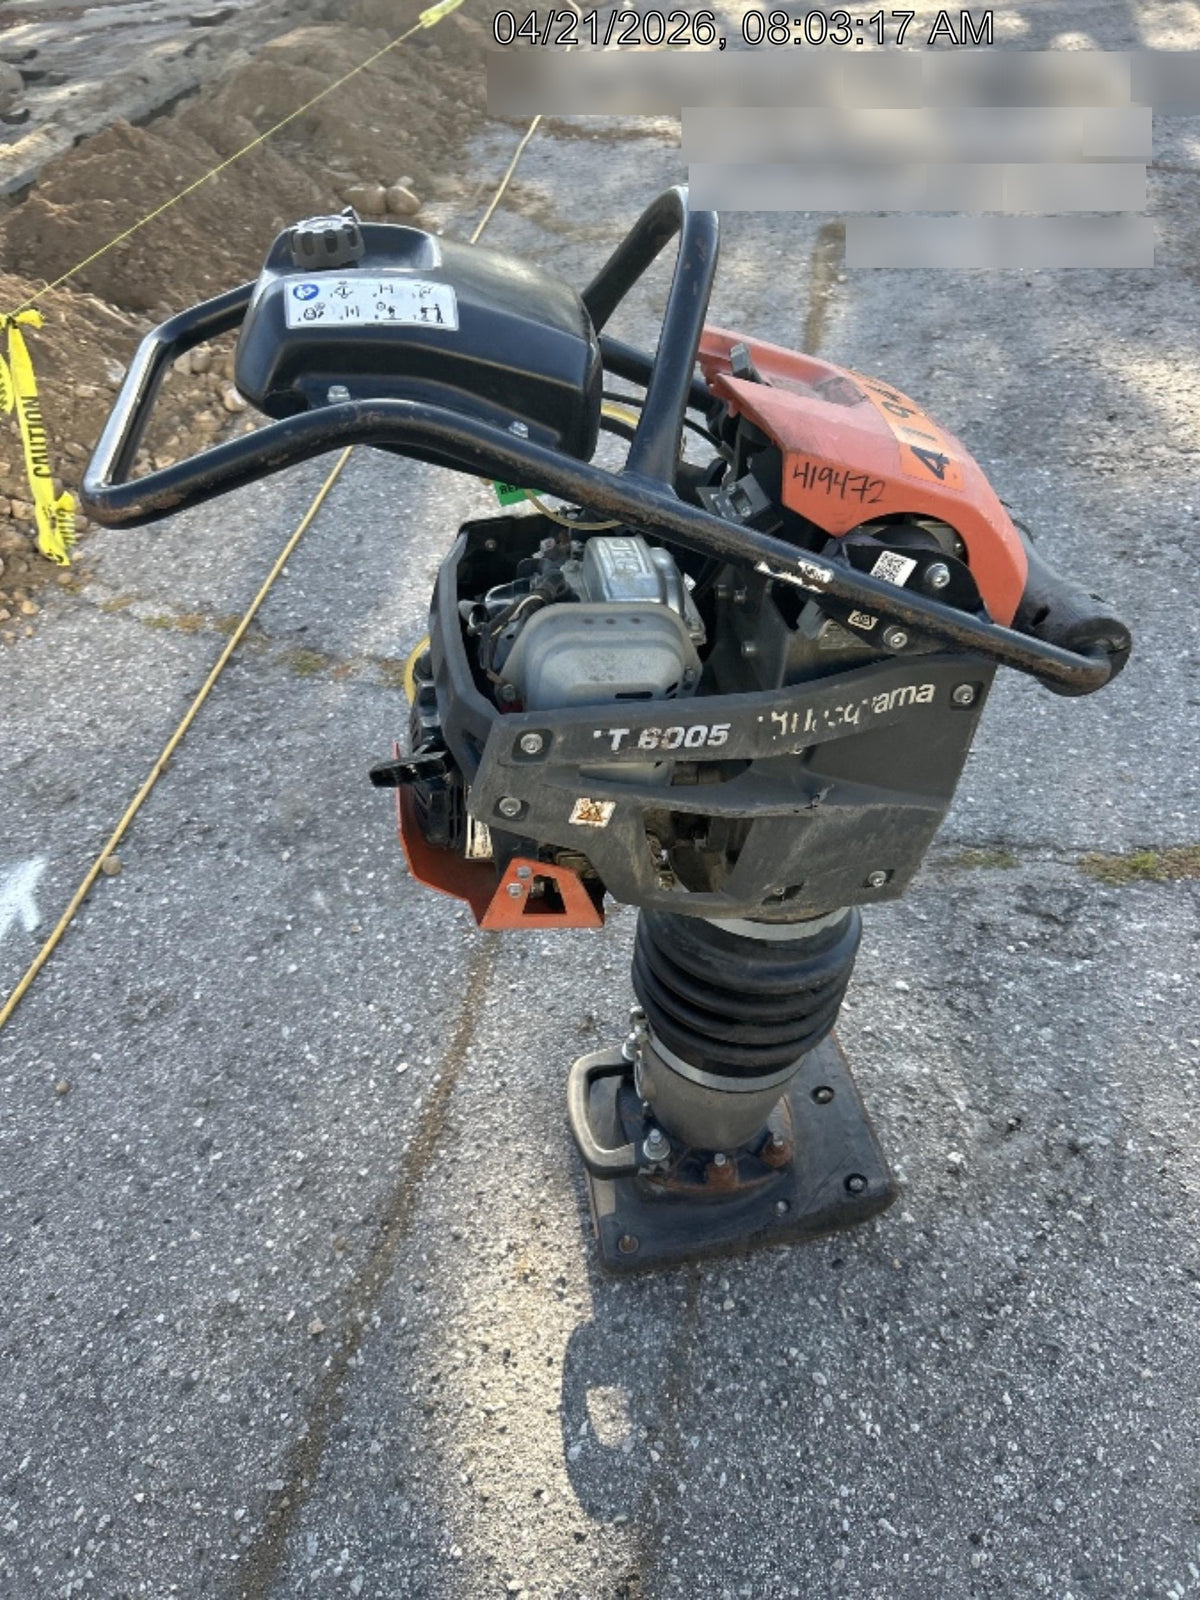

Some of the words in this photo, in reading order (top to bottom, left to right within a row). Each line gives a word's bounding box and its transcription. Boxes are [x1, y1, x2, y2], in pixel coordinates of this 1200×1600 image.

[22, 396, 52, 479] CAUTION
[793, 461, 886, 504] 419472
[637, 722, 732, 751] 6005
